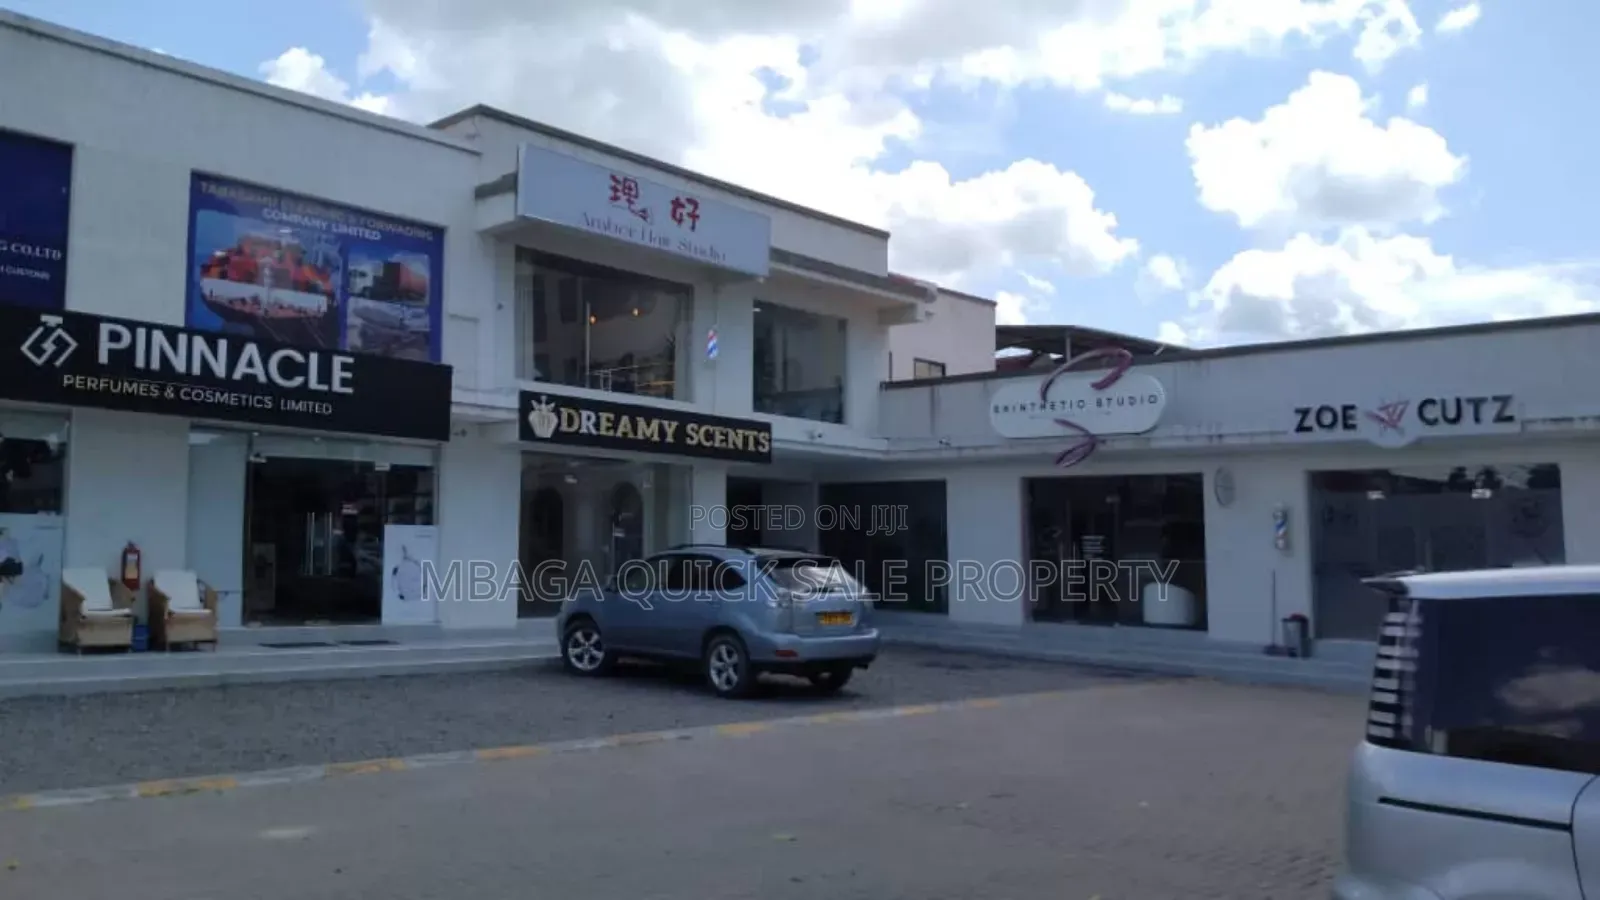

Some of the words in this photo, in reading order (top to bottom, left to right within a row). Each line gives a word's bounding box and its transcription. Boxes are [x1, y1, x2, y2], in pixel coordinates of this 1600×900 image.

[97, 323, 356, 394] PINNACLE
[63, 374, 159, 397] PERFUMES
[163, 383, 175, 400] &
[180, 386, 273, 409] COSMETICS
[280, 398, 333, 416] LIMITED
[1096, 394, 1158, 408] STUDIO
[1294, 404, 1358, 433] ZOE
[1417, 395, 1515, 426] CUTZ
[559, 407, 679, 443] DREAMY
[685, 422, 771, 453] SCENTS
